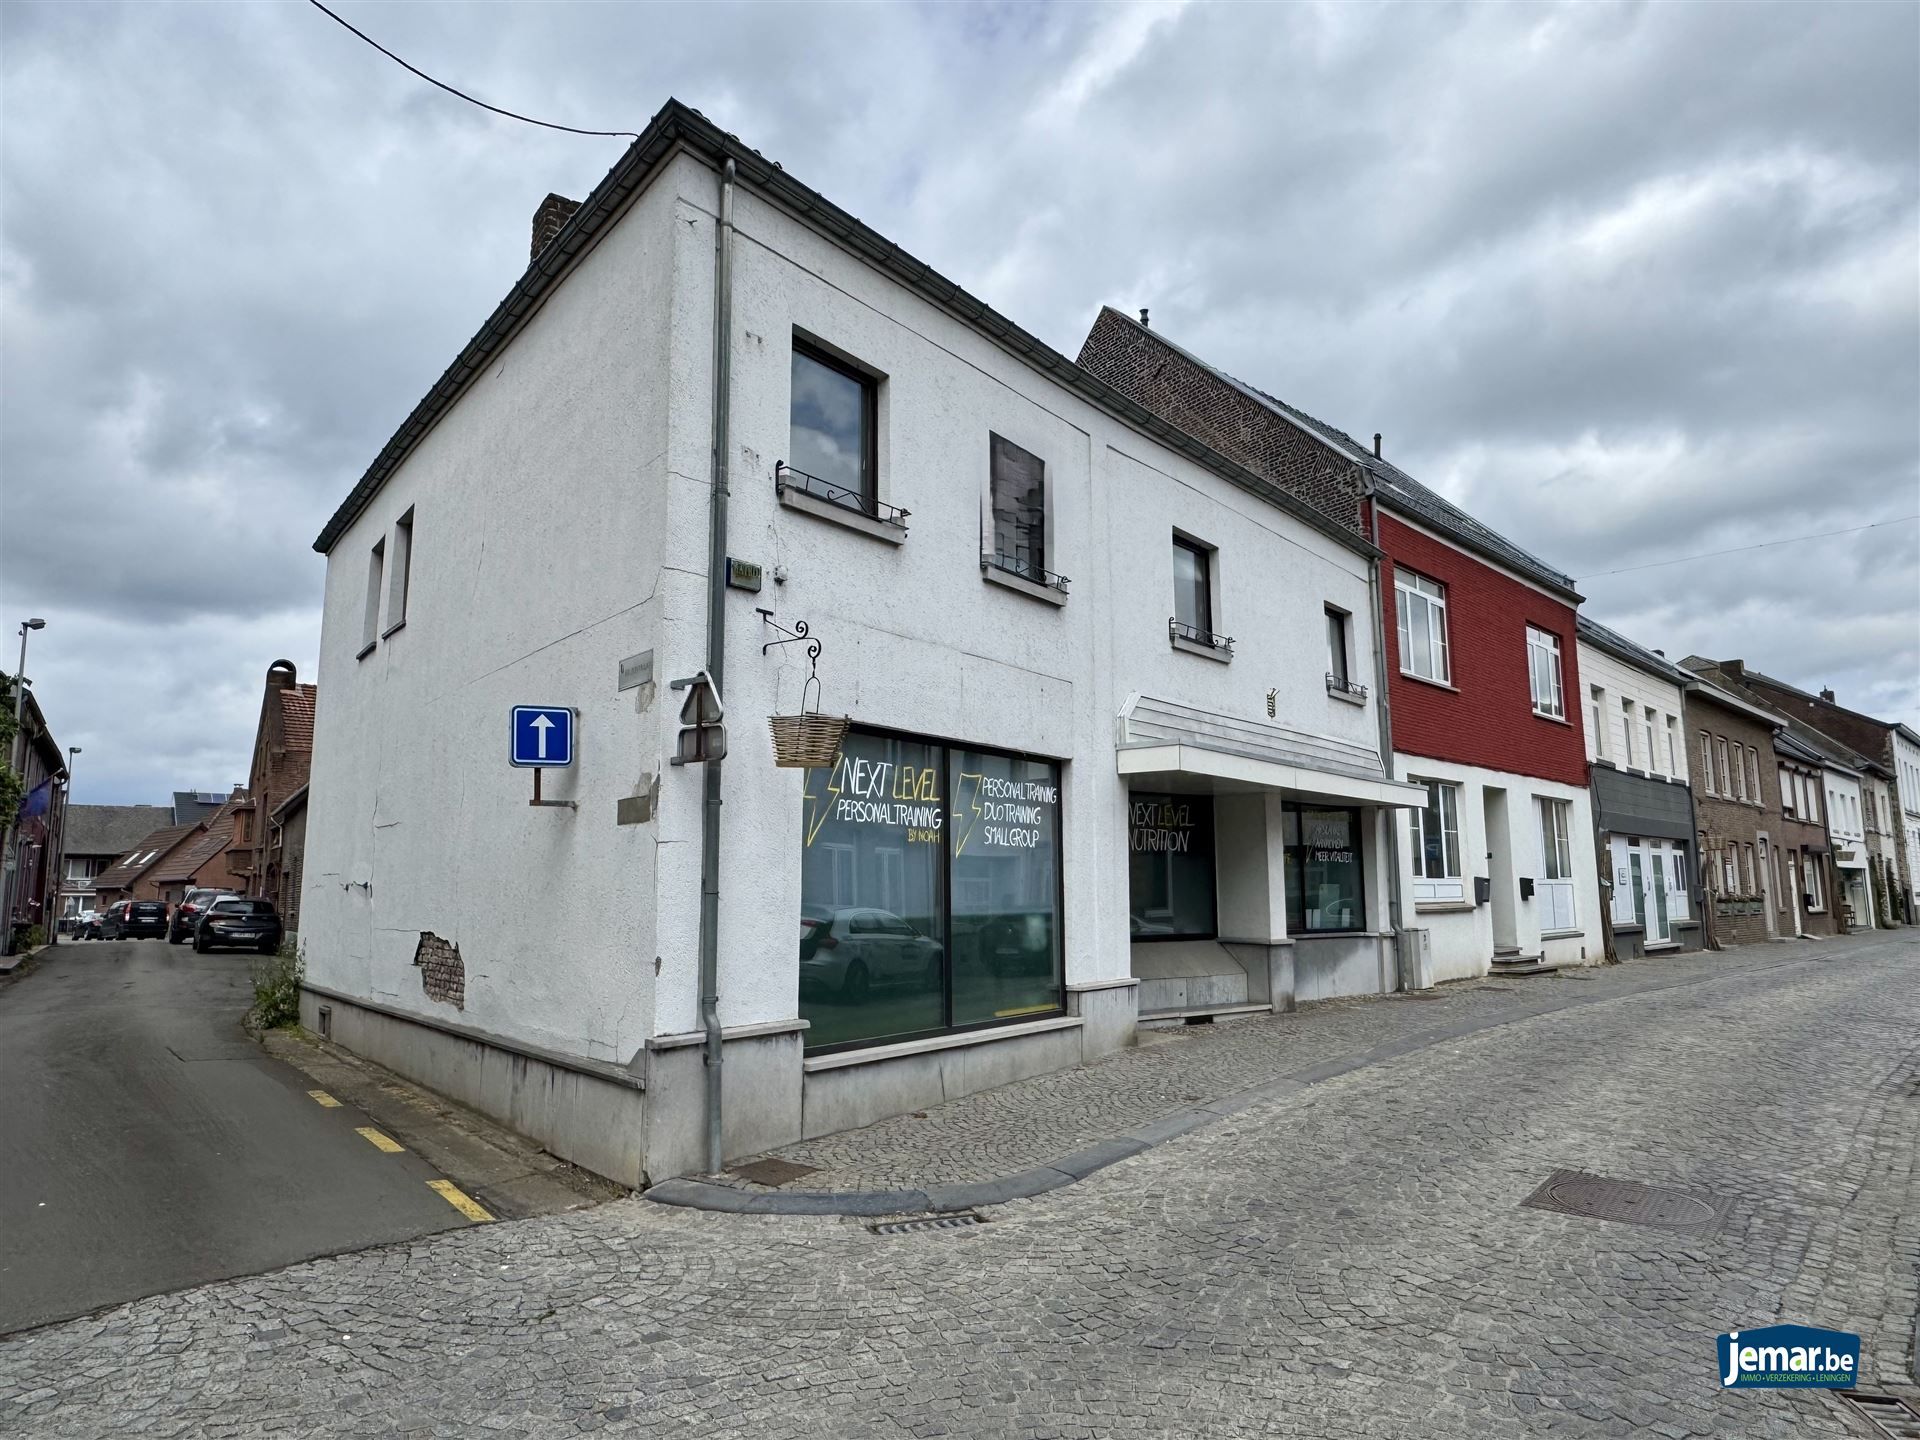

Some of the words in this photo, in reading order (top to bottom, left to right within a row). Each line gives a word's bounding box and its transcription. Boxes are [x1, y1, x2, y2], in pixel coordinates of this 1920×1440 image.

[841, 757, 891, 798] NEXT
[892, 766, 940, 801] LEVEL
[984, 802, 1004, 821] DUO
[1158, 804, 1195, 827] LEVEL
[908, 829, 917, 842] BY
[918, 830, 940, 843] NOAH
